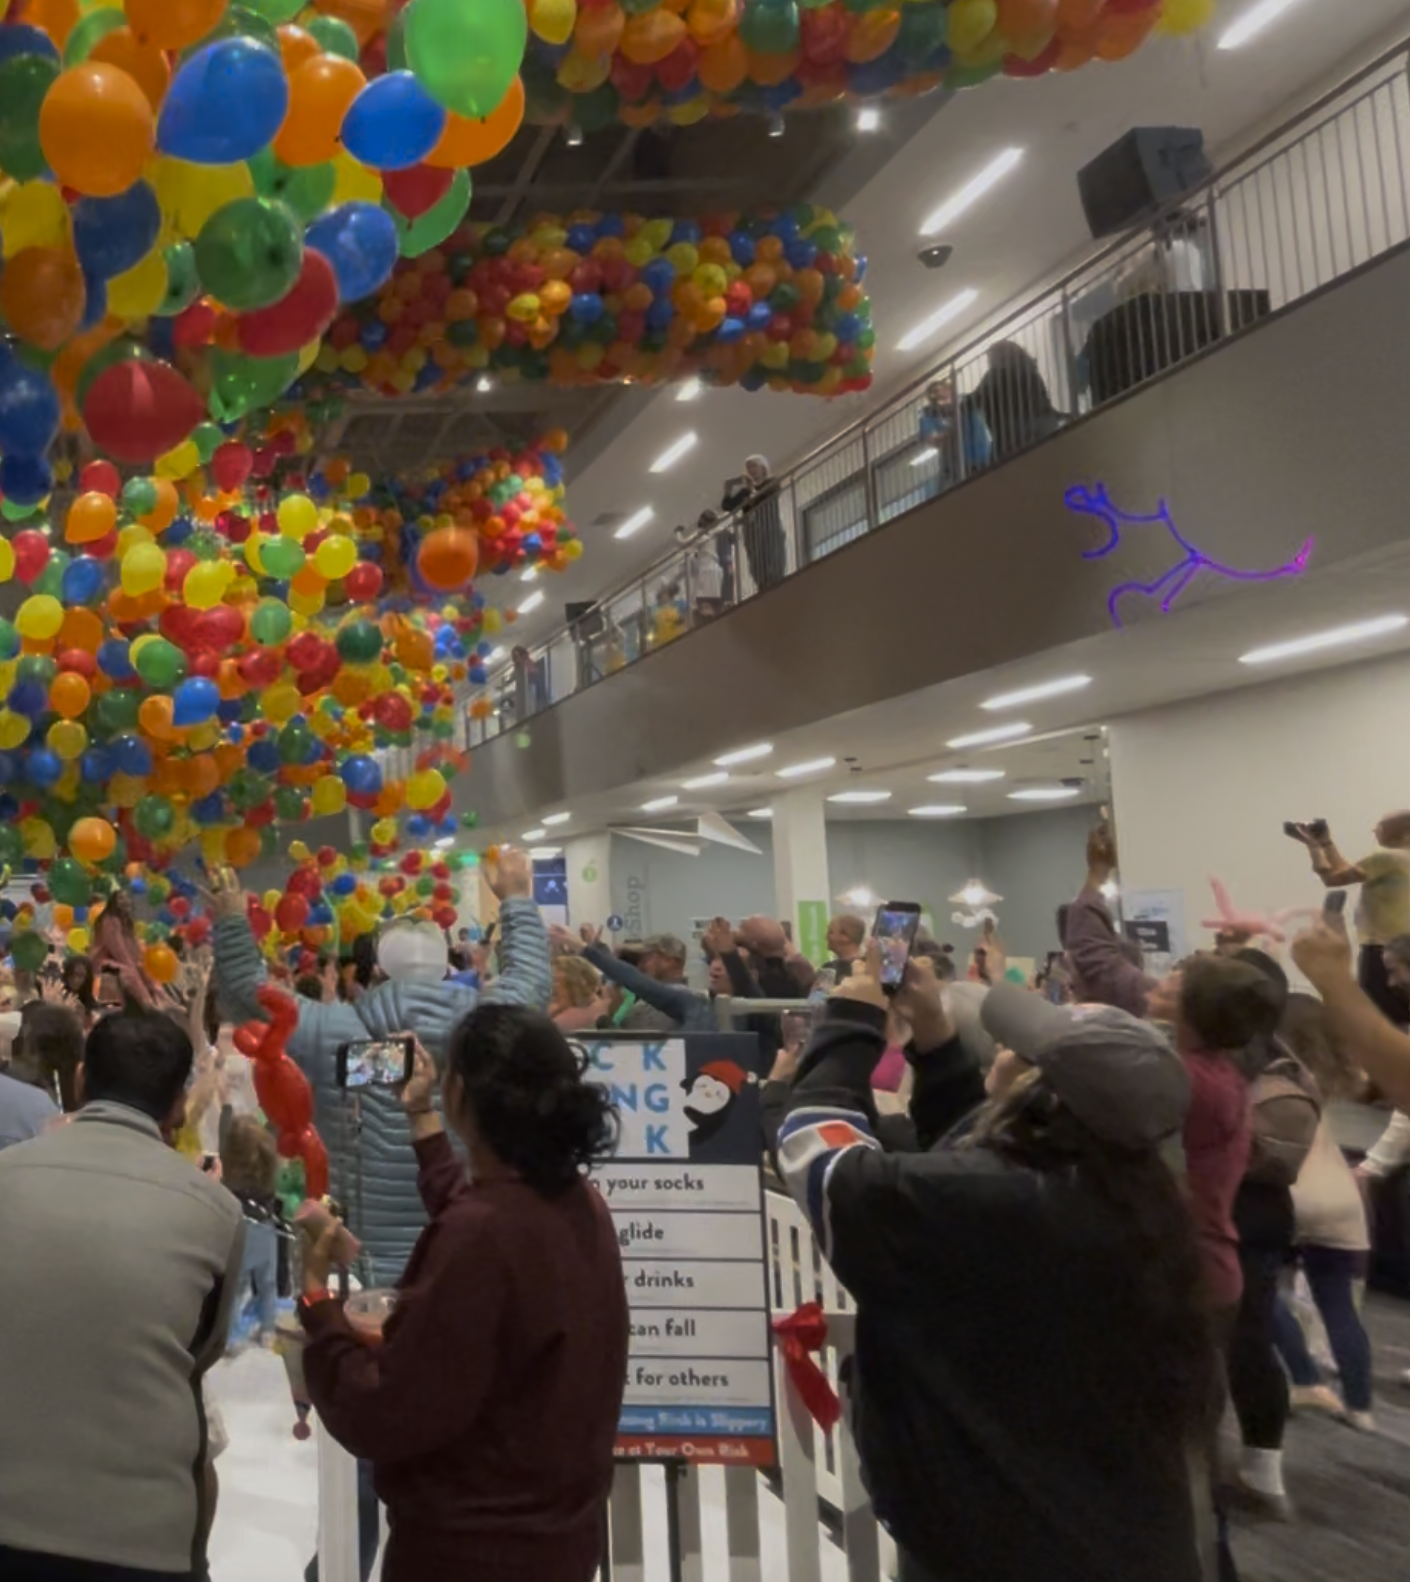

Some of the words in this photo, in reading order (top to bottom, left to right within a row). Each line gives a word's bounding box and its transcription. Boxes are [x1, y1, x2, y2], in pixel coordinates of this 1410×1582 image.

[606, 1178, 648, 1196] your
[654, 1173, 704, 1191] socks
[618, 1221, 665, 1246] glide
[634, 1268, 694, 1288] drinks
[628, 1324, 660, 1337] can
[665, 1318, 696, 1337] fall
[636, 1367, 663, 1386] for
[669, 1368, 729, 1387] others
[645, 1442, 677, 1457] Your
[681, 1442, 715, 1457] Own
